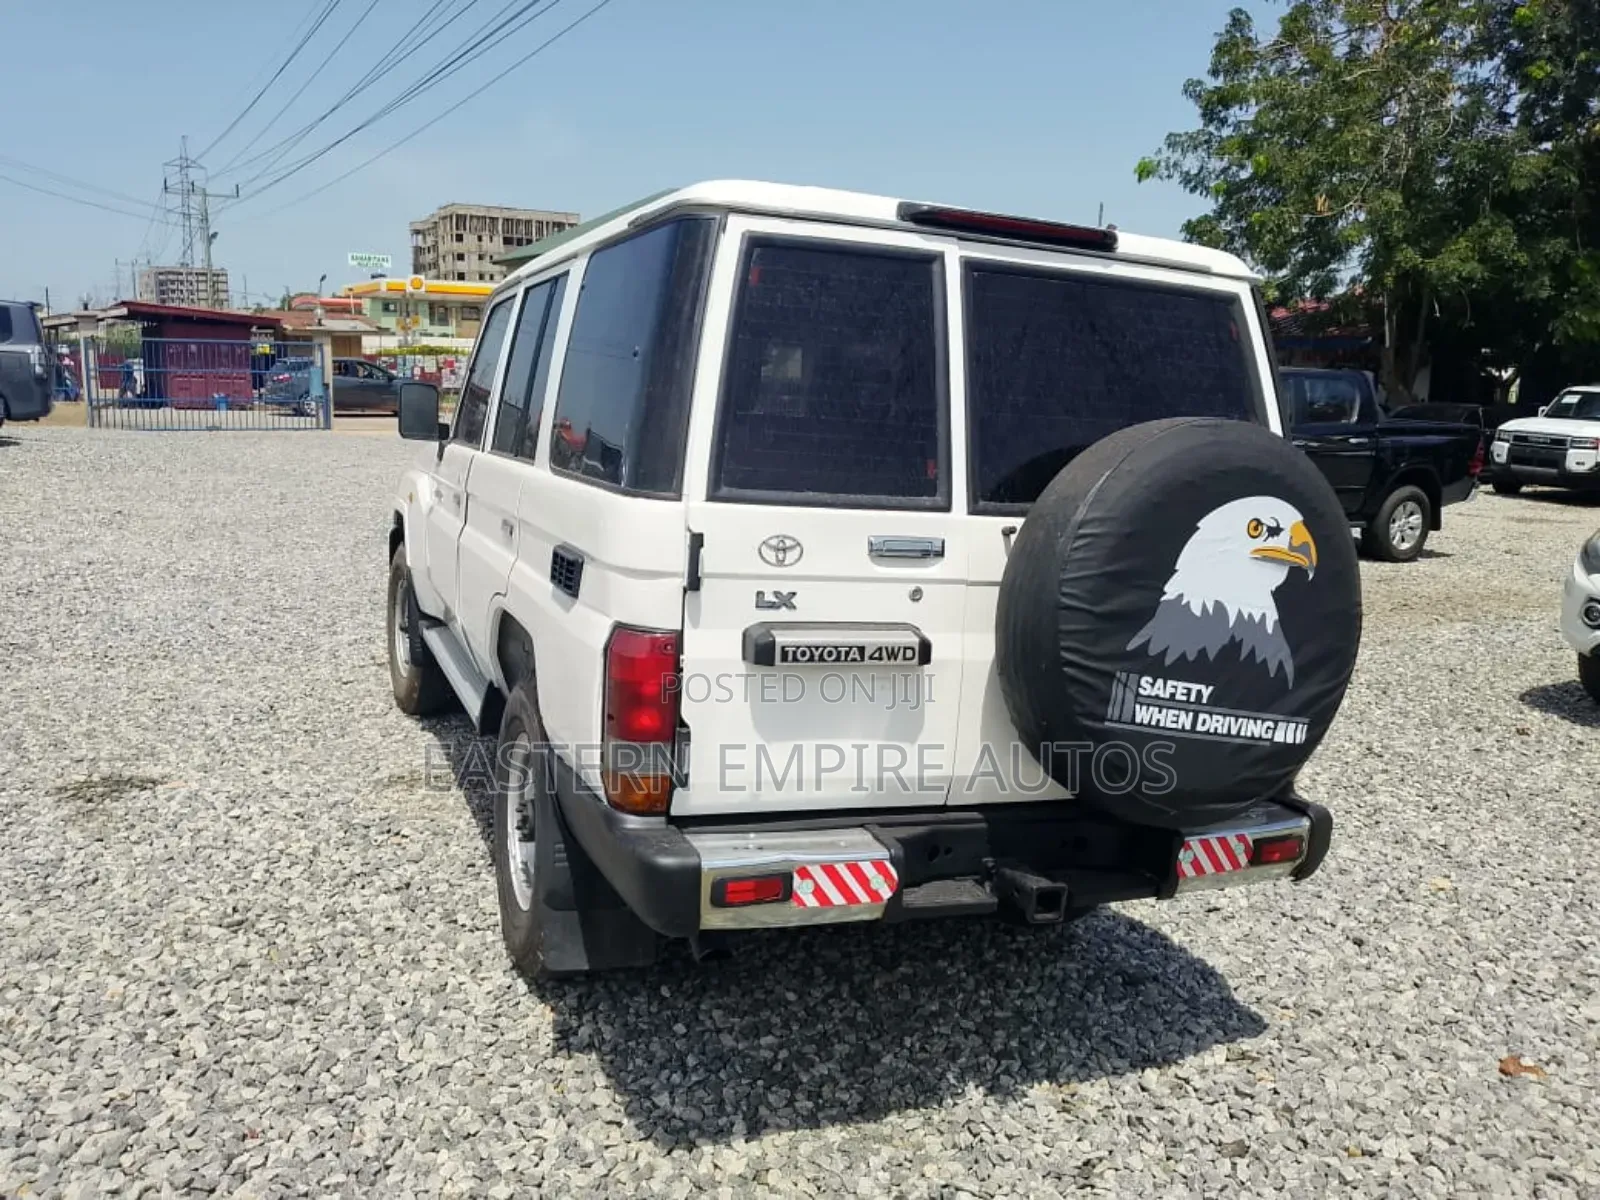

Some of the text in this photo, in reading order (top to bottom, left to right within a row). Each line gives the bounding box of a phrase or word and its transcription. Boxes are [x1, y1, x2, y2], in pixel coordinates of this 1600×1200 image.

[755, 590, 797, 610] LX
[783, 646, 916, 662] TOYOTA 4WD
[1138, 676, 1215, 704] SAFETY
[1134, 704, 1274, 740] WHEN DRIVING
